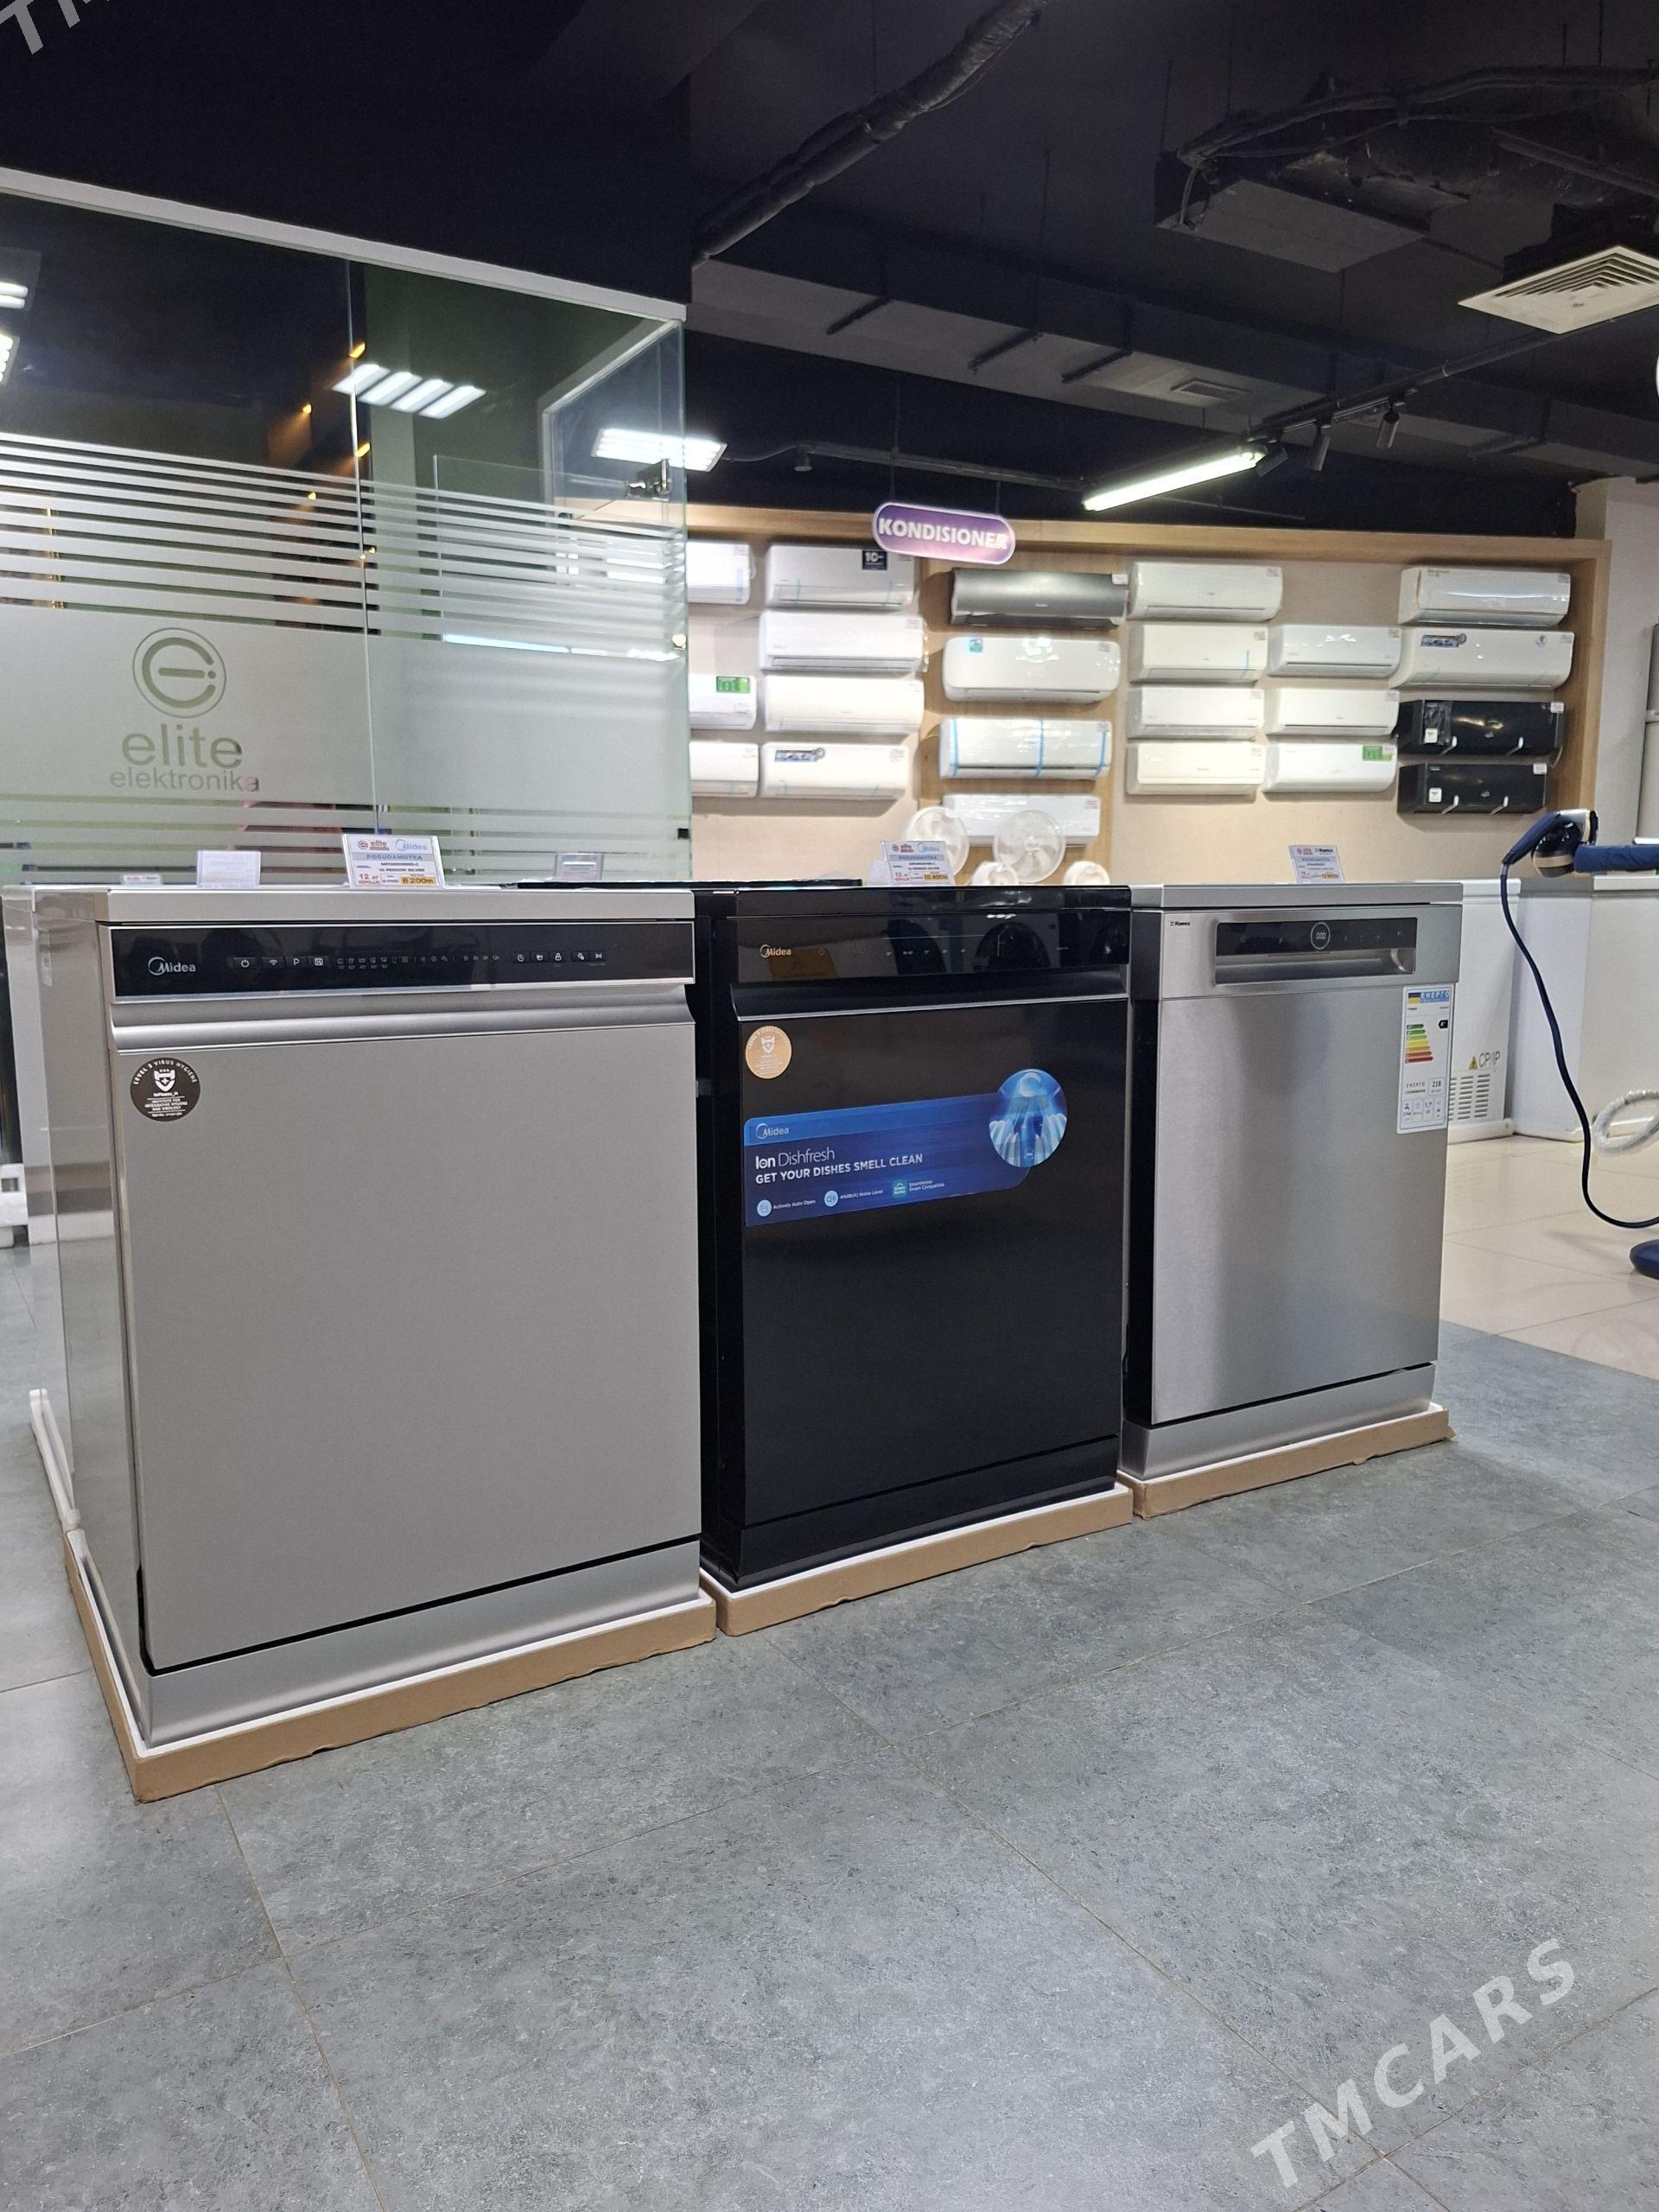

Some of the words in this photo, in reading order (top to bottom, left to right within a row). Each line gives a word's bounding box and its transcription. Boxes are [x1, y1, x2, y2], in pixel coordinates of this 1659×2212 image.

[879, 518, 1008, 550] KONDISIONER
[122, 724, 243, 769] elite
[110, 767, 259, 792] elektronika
[760, 944, 792, 958] Midea
[148, 957, 196, 976] Midea
[755, 1123, 790, 1140] Midea
[755, 1154, 776, 1170] Ion
[778, 1146, 836, 1167] Dishfresh
[755, 1172, 778, 1185] GET
[779, 1167, 810, 1181] YOUR
[813, 1163, 851, 1177] DISHES
[854, 1159, 887, 1172] SMELL
[889, 1154, 924, 1166] CLEAN
